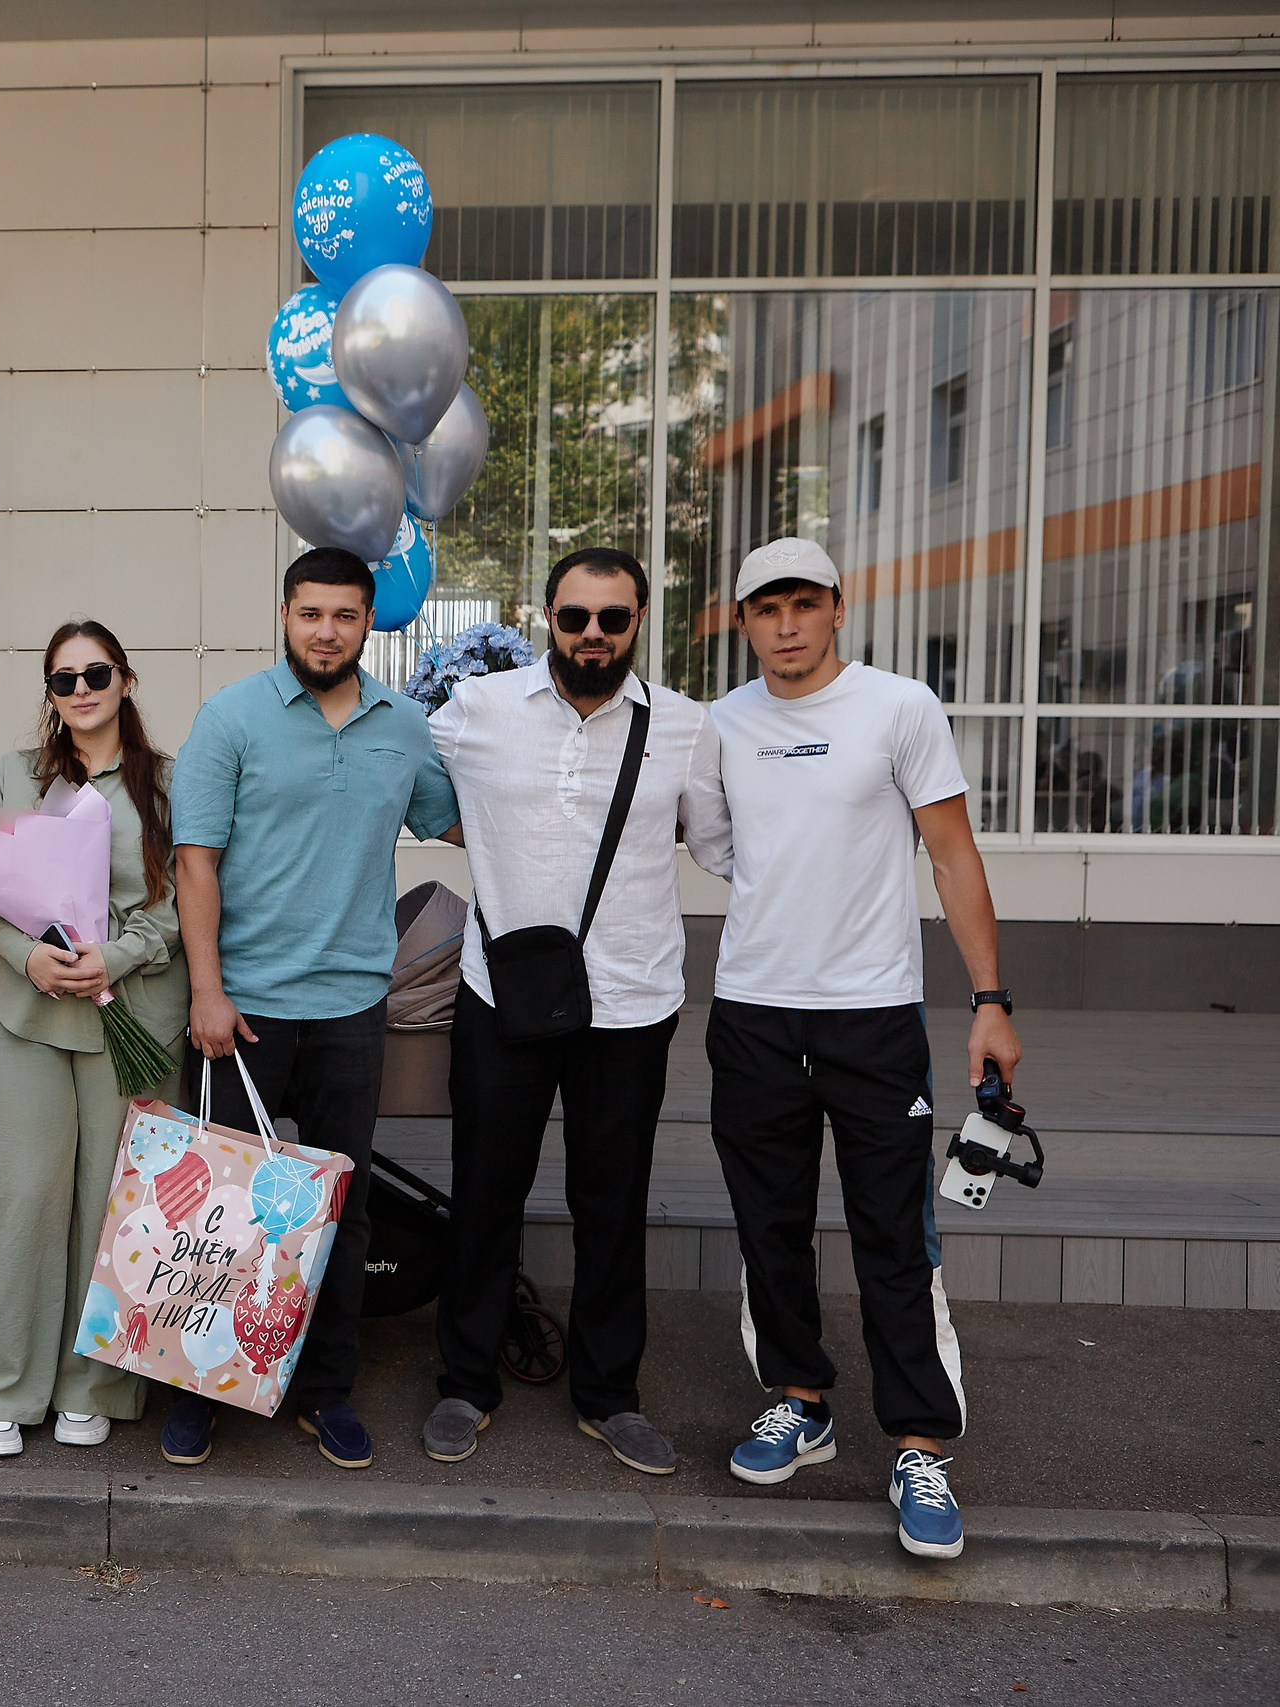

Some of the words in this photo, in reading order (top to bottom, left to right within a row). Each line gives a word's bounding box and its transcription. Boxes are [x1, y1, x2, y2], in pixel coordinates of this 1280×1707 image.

[297, 194, 353, 218] маленькое
[305, 210, 336, 235] чудо
[204, 1204, 226, 1234] С
[364, 1260, 398, 1274] lephy
[146, 1261, 242, 1305] РОЖДЕ
[150, 1301, 218, 1338] НИЯ!
